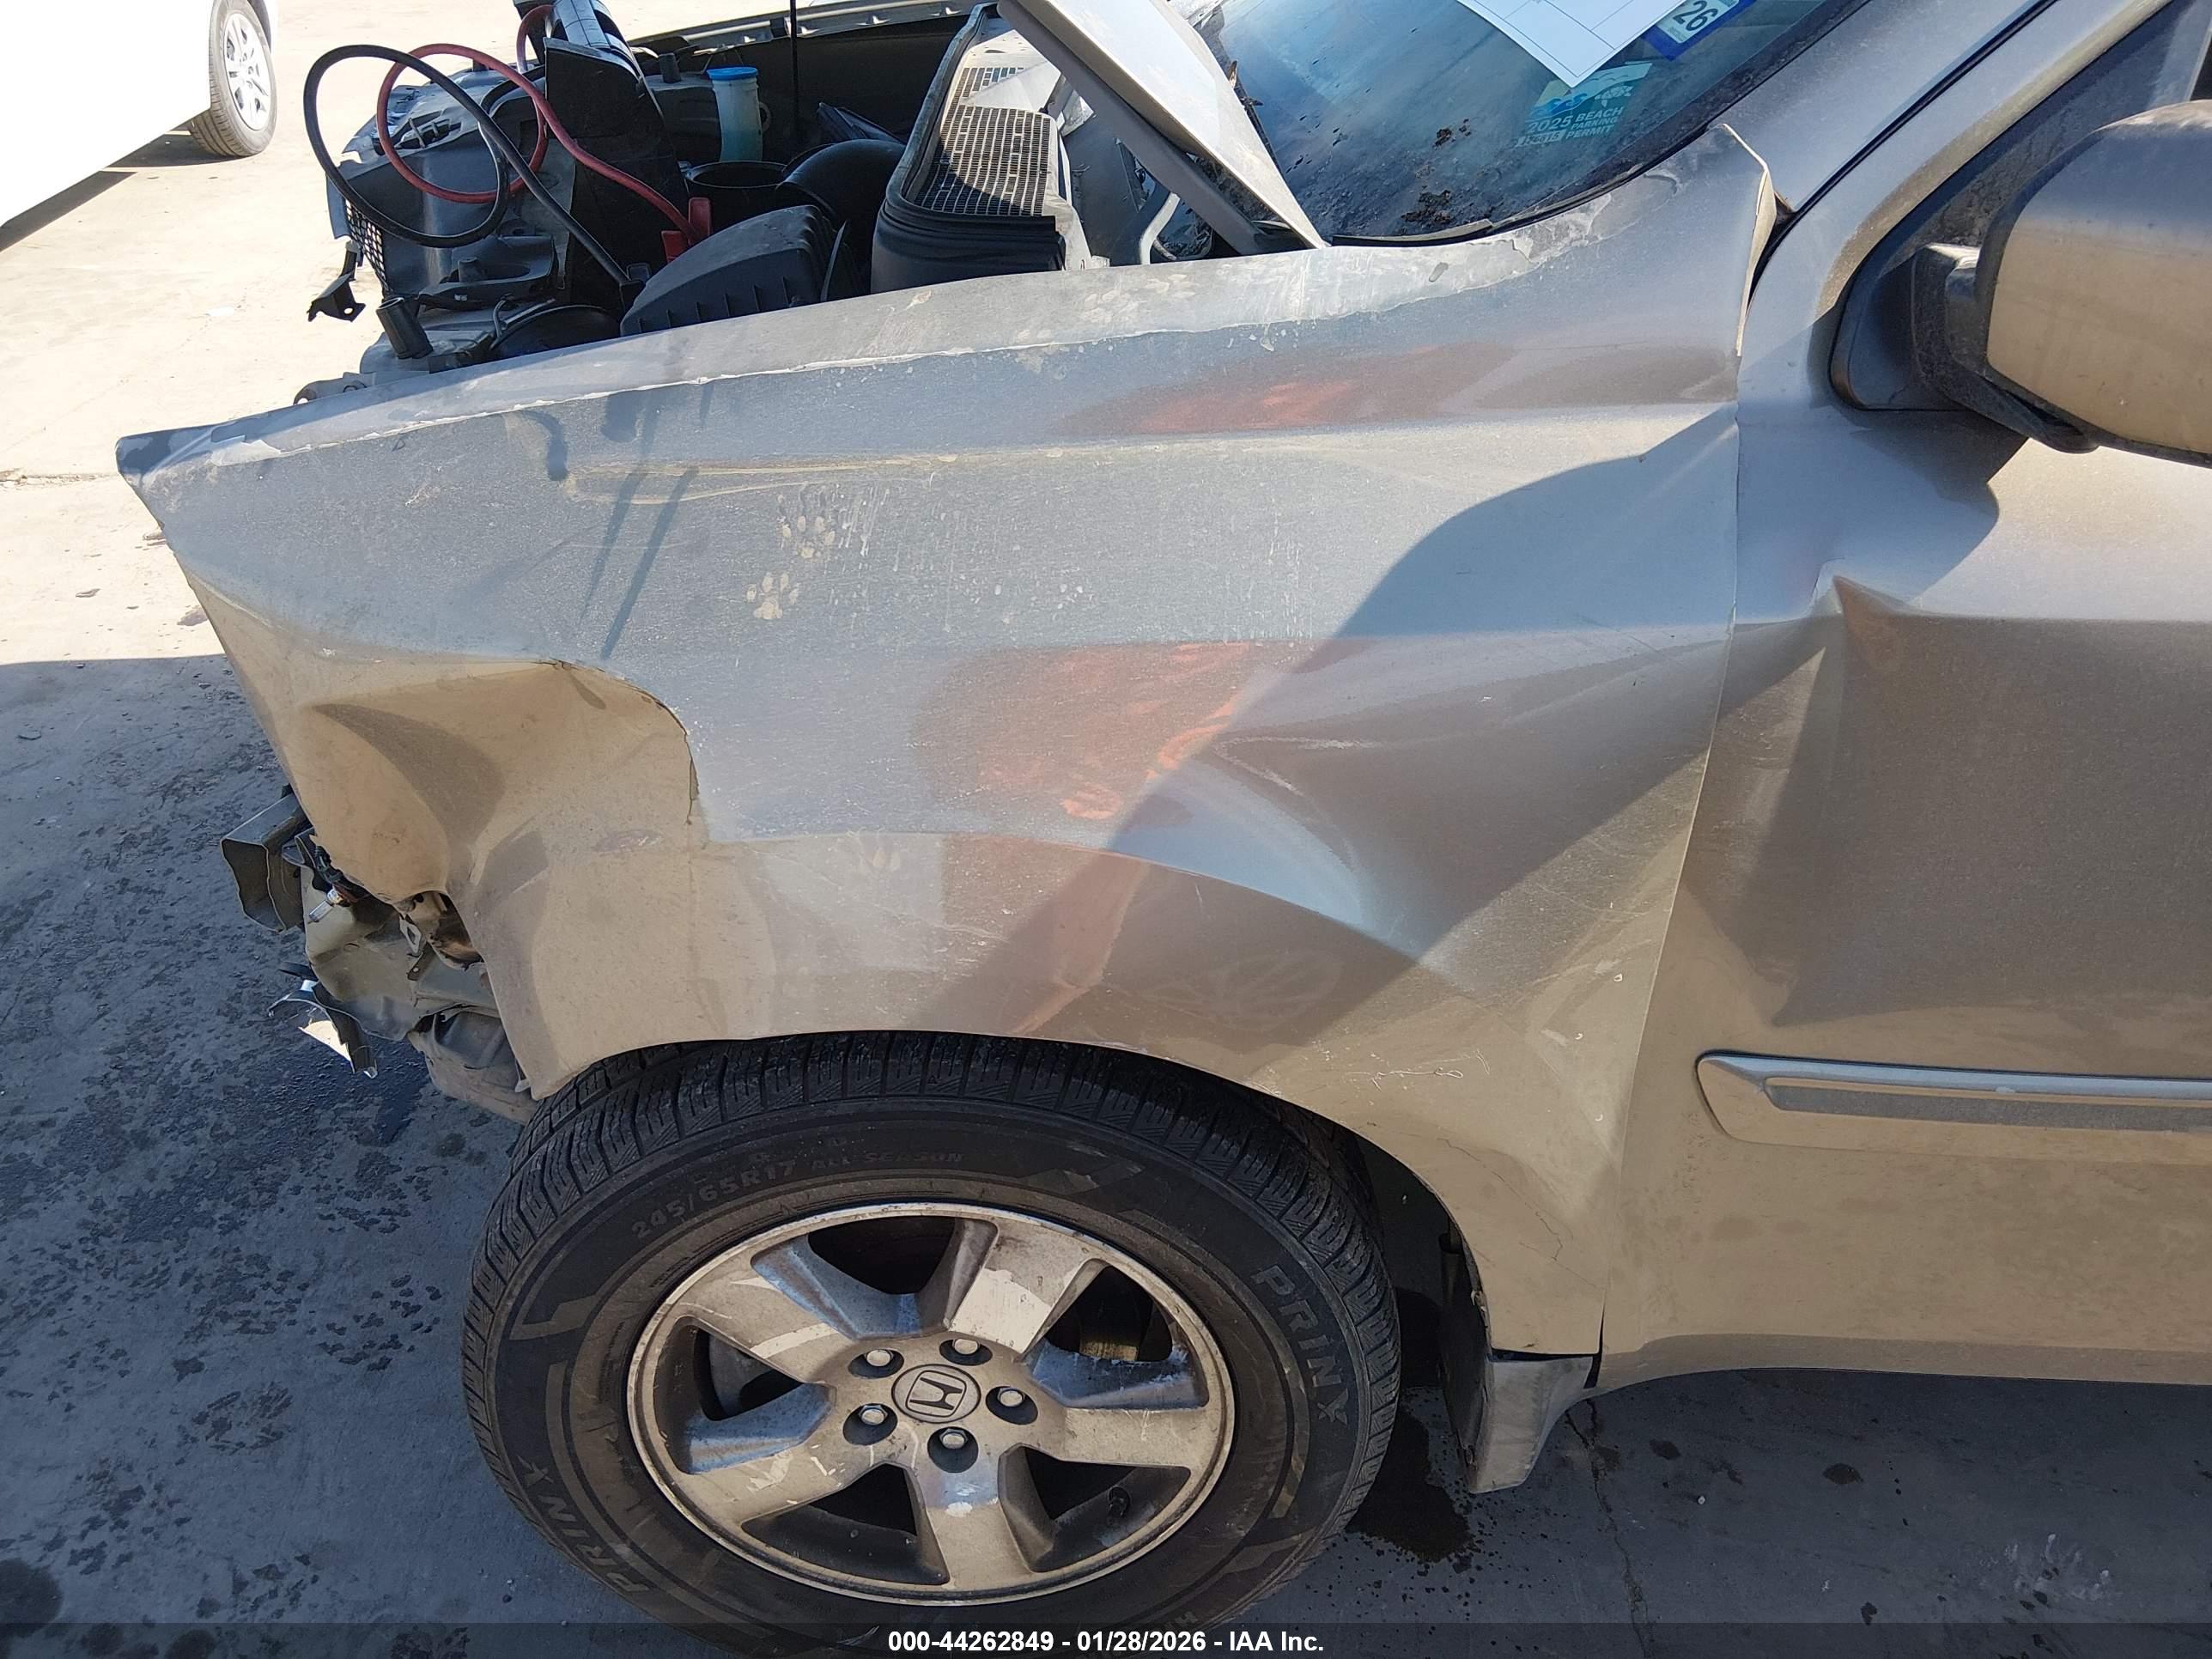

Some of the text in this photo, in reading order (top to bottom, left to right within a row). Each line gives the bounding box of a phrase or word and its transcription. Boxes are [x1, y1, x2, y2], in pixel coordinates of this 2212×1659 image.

[1673, 0, 1718, 32] 26
[1526, 114, 1574, 134] 2025
[1571, 116, 1619, 131] PARKING
[1575, 106, 1625, 123] BEACH
[1565, 125, 1615, 139] PERMIT
[631, 1159, 797, 1239] 245/65R17
[1249, 1265, 1351, 1425] PRINX
